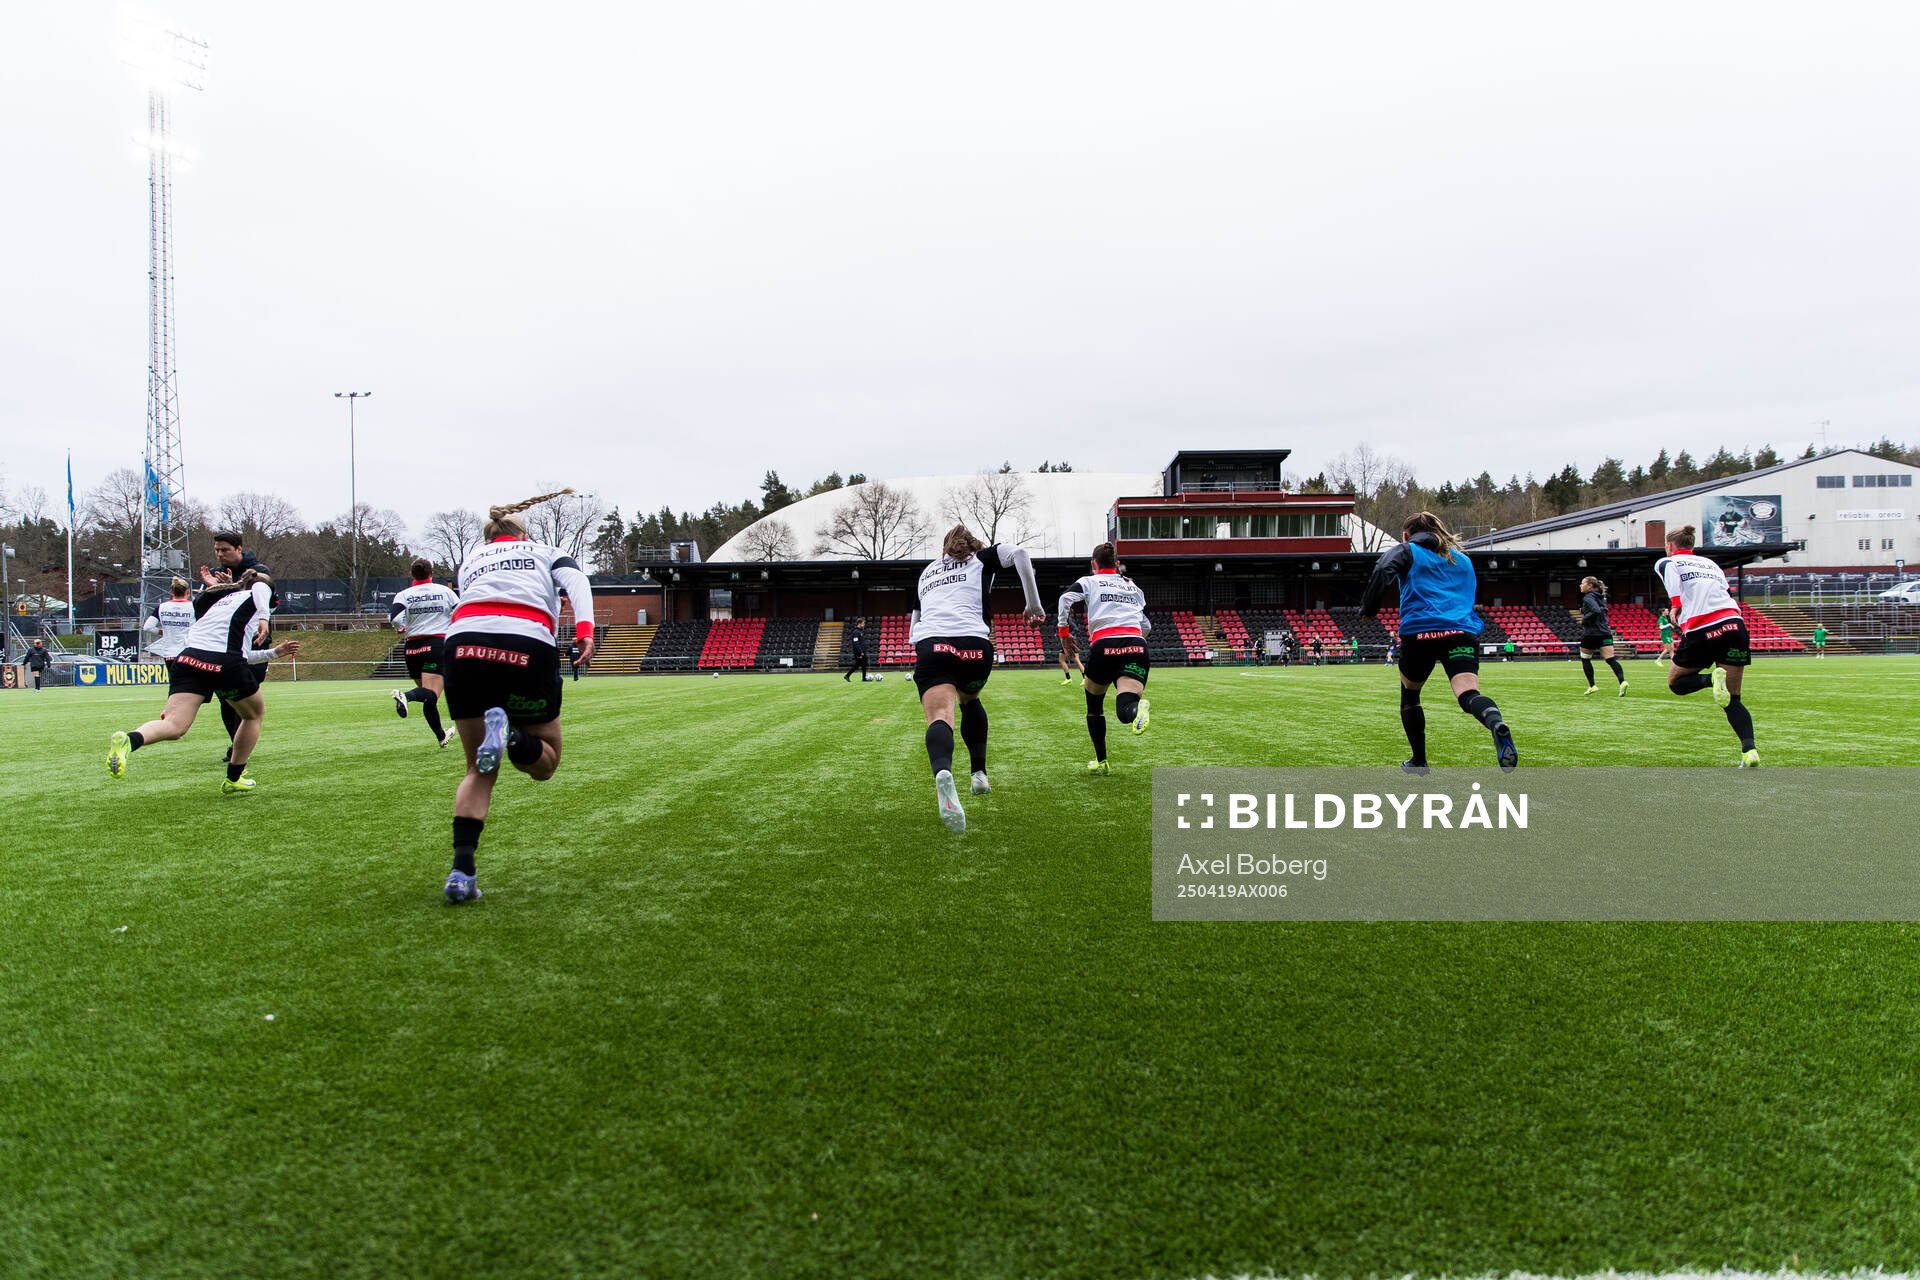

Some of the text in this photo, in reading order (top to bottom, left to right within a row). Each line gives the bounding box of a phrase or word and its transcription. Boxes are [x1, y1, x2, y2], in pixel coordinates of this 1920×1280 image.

[463, 559, 535, 591] BAUHAUS
[406, 594, 444, 604] stadium
[160, 610, 191, 618] stadium
[1706, 623, 1738, 640] BAUAUS
[101, 635, 118, 649] BP
[456, 646, 530, 666] BAUHAUS
[1104, 646, 1145, 655] BAUHAUS
[178, 655, 222, 672] BAUHAUS
